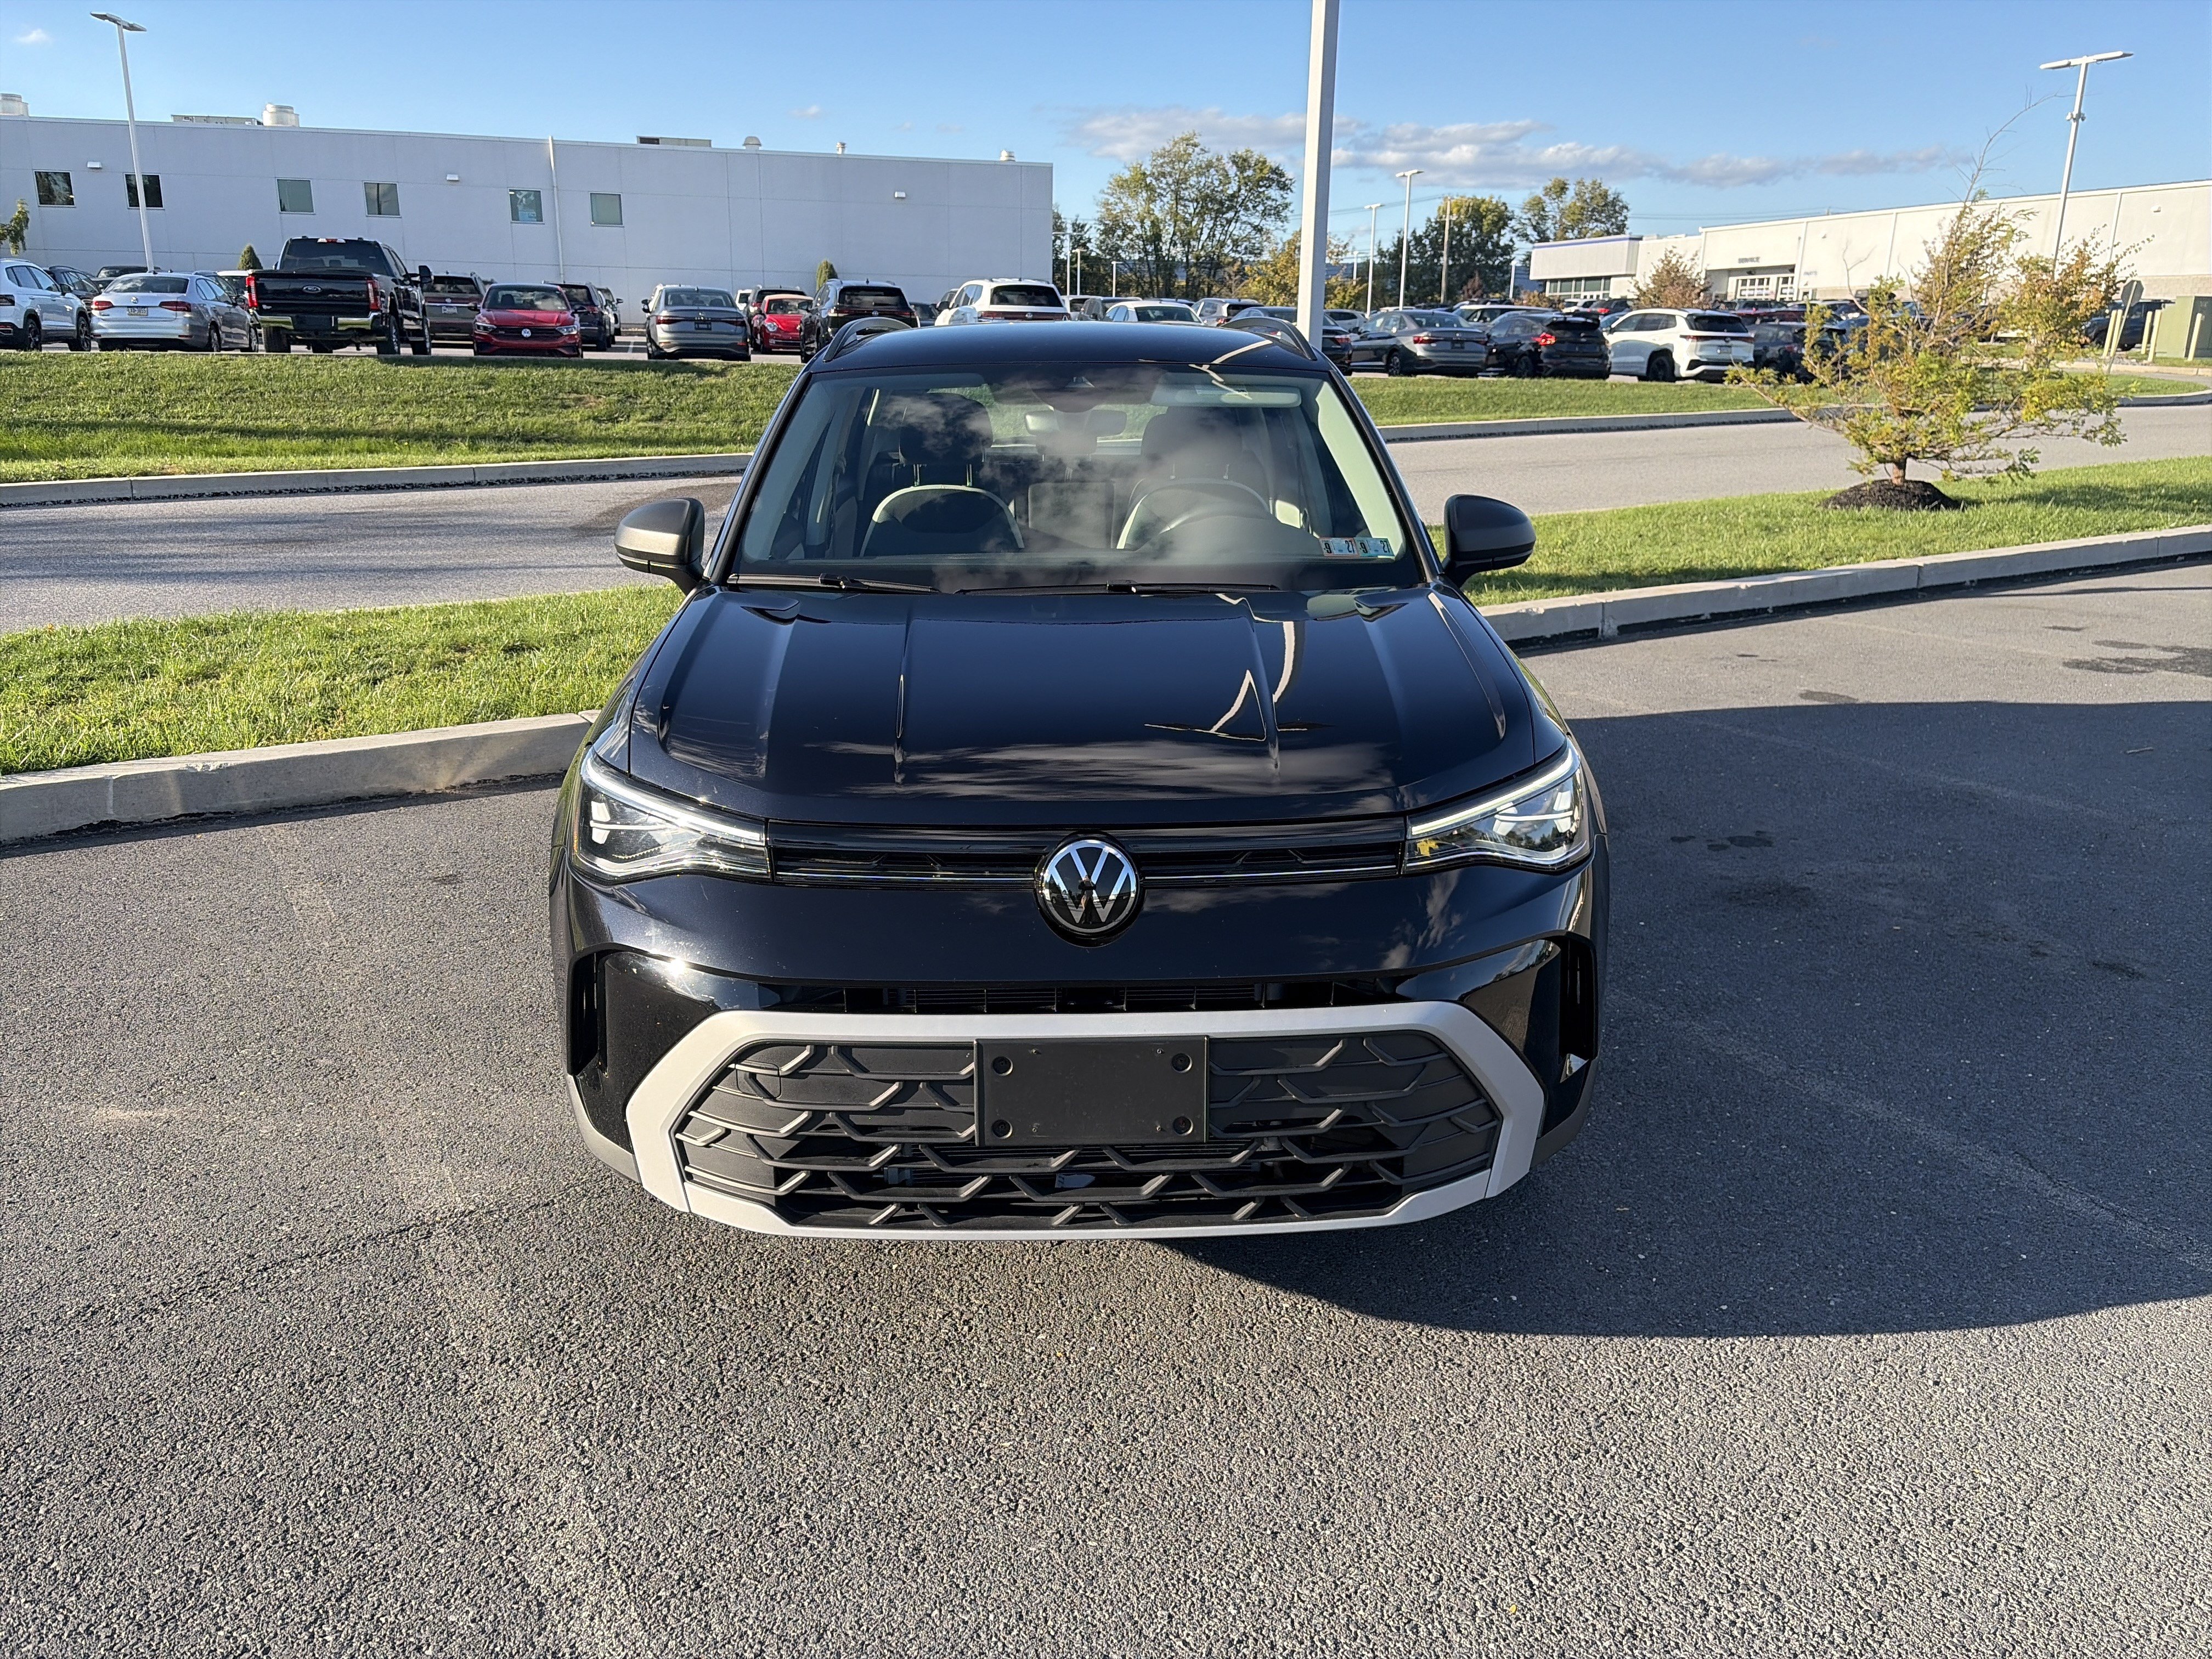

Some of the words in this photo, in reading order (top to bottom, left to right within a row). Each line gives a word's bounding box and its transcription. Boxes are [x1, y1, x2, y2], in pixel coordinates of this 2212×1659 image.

[1324, 543, 1332, 554] 9
[1345, 540, 1355, 554] 27
[1360, 542, 1368, 554] 9
[1380, 540, 1390, 554] 27
